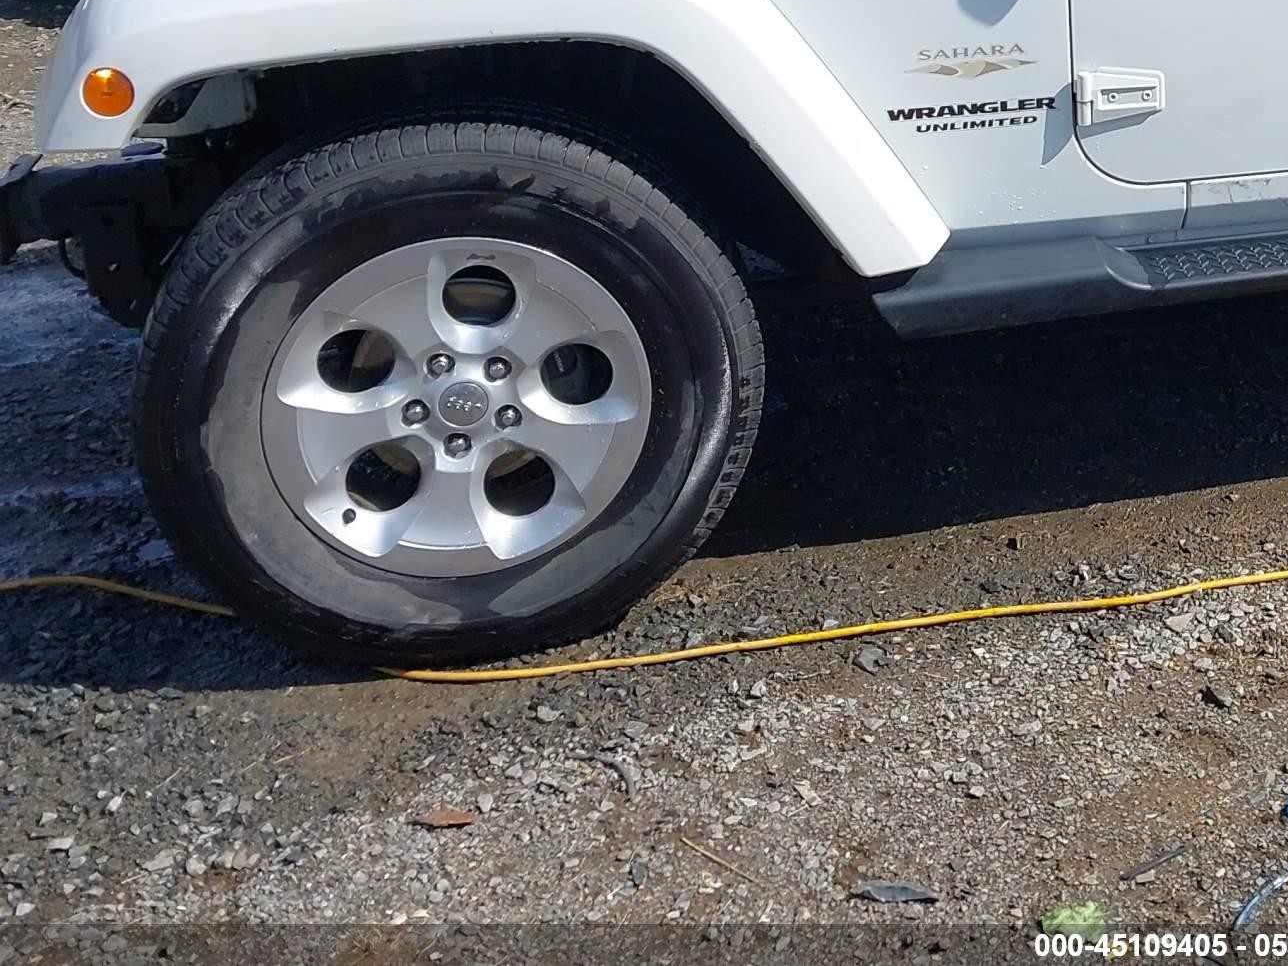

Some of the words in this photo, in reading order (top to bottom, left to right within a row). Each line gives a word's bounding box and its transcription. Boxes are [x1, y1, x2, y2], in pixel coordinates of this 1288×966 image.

[918, 43, 1025, 61] SAHARA
[886, 96, 1057, 122] WRANGLER
[915, 115, 1038, 133] UNLIMITED
